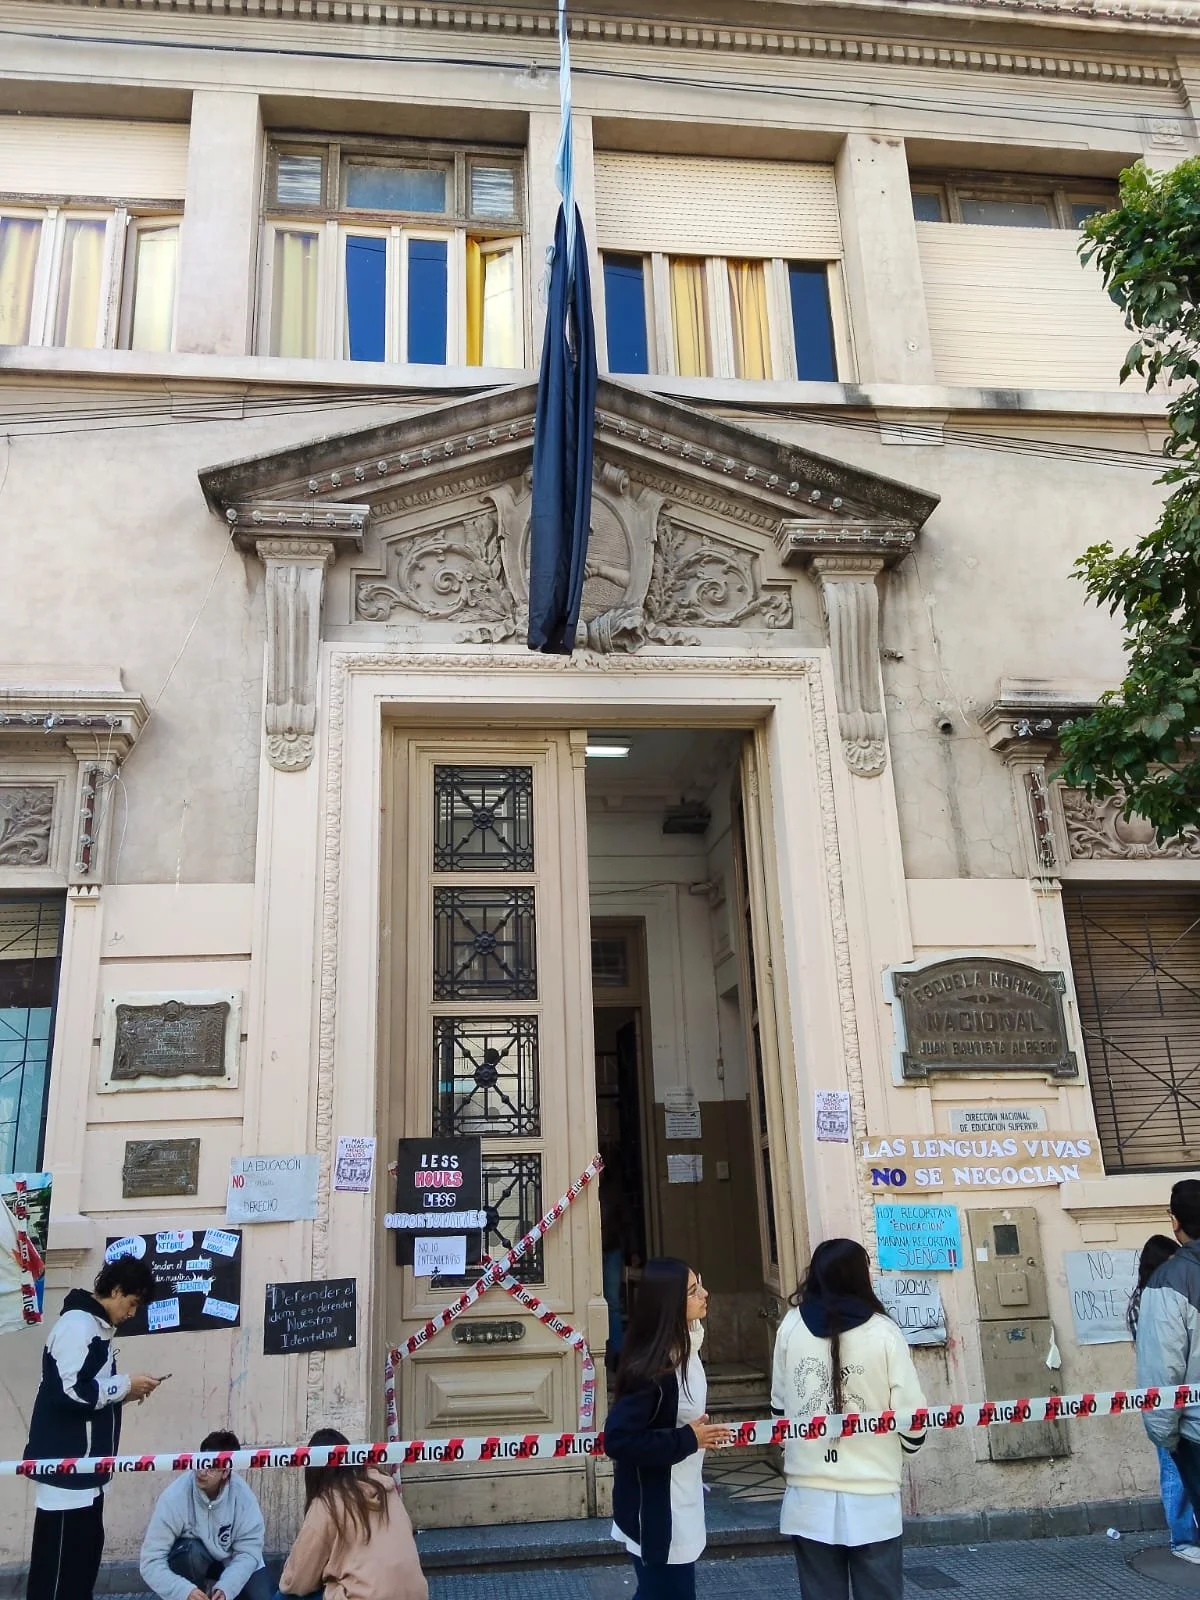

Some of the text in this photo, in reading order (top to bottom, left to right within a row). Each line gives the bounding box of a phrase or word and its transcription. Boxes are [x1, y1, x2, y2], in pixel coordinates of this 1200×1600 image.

[912, 970, 1051, 1008] ESCUELA NORMAL
[924, 1009, 1045, 1033] NACIONAL
[919, 1040, 947, 1056] JUAN
[952, 1039, 1005, 1056] BAUTISTA
[1000, 1111, 1031, 1121] NACIONAL
[959, 1124, 971, 1133] DE
[861, 1138, 1092, 1159] LAS LENGUAS VIVAS
[242, 1160, 254, 1173] LA
[421, 1154, 459, 1169] LESS
[232, 1175, 245, 1188] NO
[415, 1171, 463, 1188] HOURS
[871, 1164, 1081, 1186] NO SE NEGOCIAN
[423, 1193, 456, 1207] LESS
[383, 1210, 488, 1229] OPPORTUNITIES
[876, 1206, 952, 1219] HOY RECORTAN
[912, 1235, 957, 1247] RECORTAN
[1087, 1251, 1114, 1281] NO
[270, 1280, 354, 1310] Defender el
[895, 1278, 931, 1296] IDIOMA
[1074, 1287, 1119, 1321] CORTE
[287, 1315, 333, 1332] Nuestra
[280, 1326, 338, 1349] Identidad
[172, 1457, 234, 1471] PELIGRO
[250, 1453, 311, 1468] PELIGRO
[327, 1449, 388, 1466] PELIGRO
[404, 1445, 464, 1461] PELIGRO
[480, 1441, 539, 1458] PELIGRO
[772, 1422, 828, 1440] PELIGRO
[842, 1416, 897, 1434] PELIGRO
[911, 1411, 965, 1428] PELIGRO
[978, 1405, 1032, 1422] PELIGRO
[1045, 1399, 1097, 1417] PELIGRO
[1109, 1394, 1162, 1411] PELIGRO
[1174, 1389, 1200, 1405] PELI
